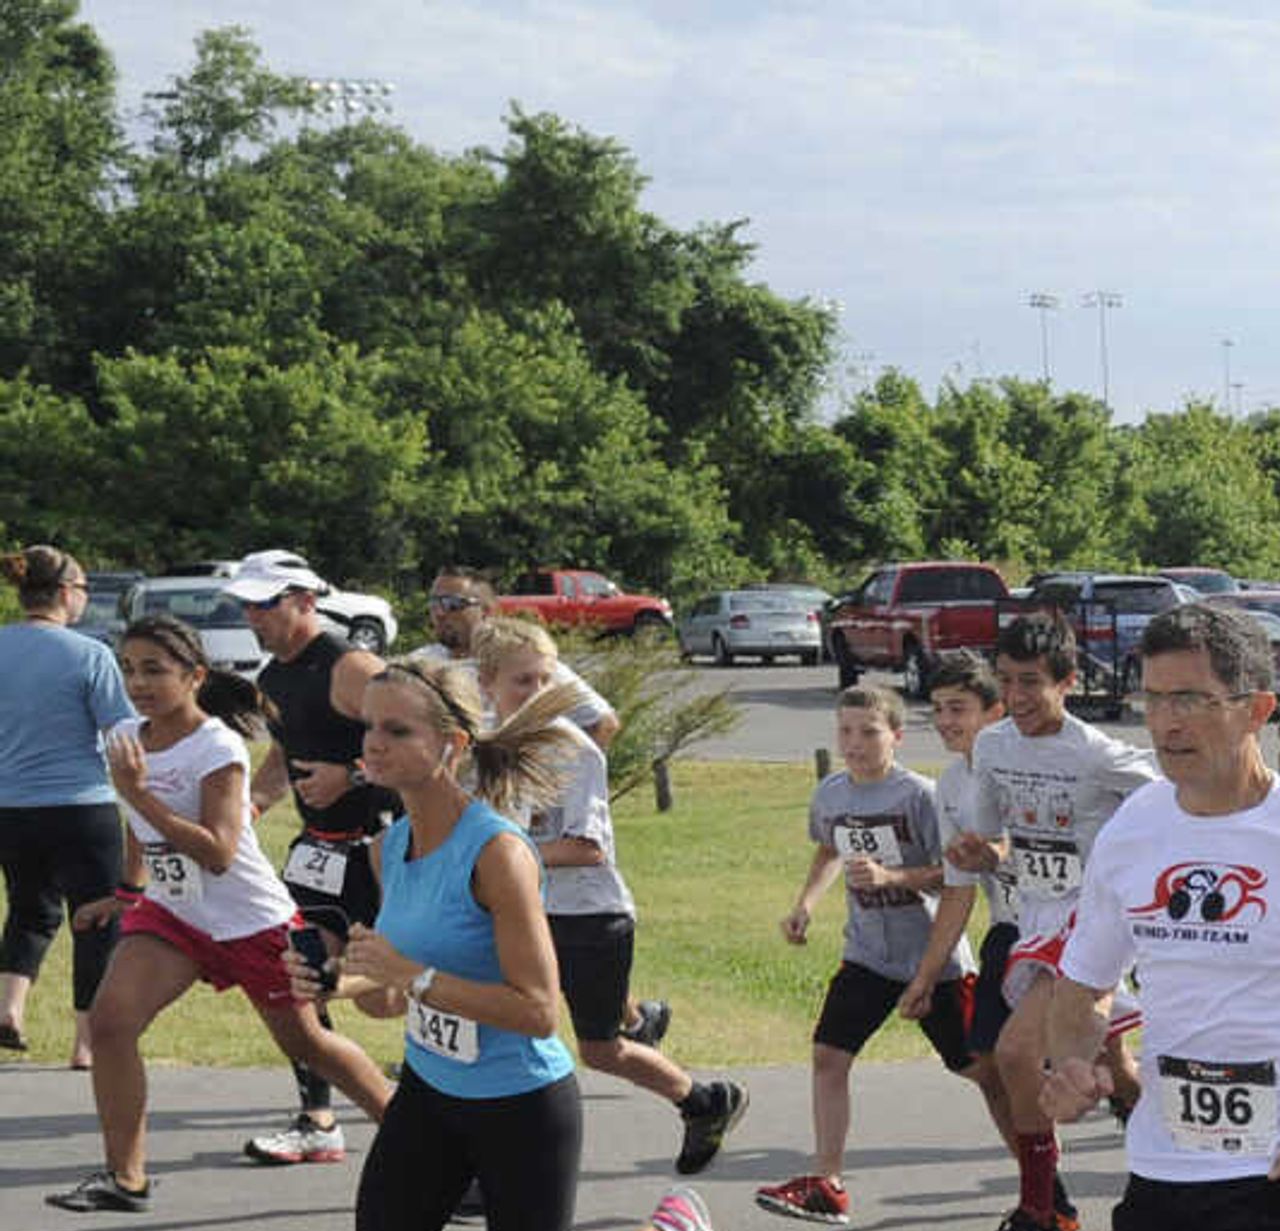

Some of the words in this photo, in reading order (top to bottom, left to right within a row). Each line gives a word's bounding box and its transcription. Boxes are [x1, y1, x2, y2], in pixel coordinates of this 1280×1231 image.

[849, 830, 878, 852] 68
[307, 851, 329, 873] 21
[1024, 852, 1068, 879] 217
[1180, 1083, 1253, 1126] 196
